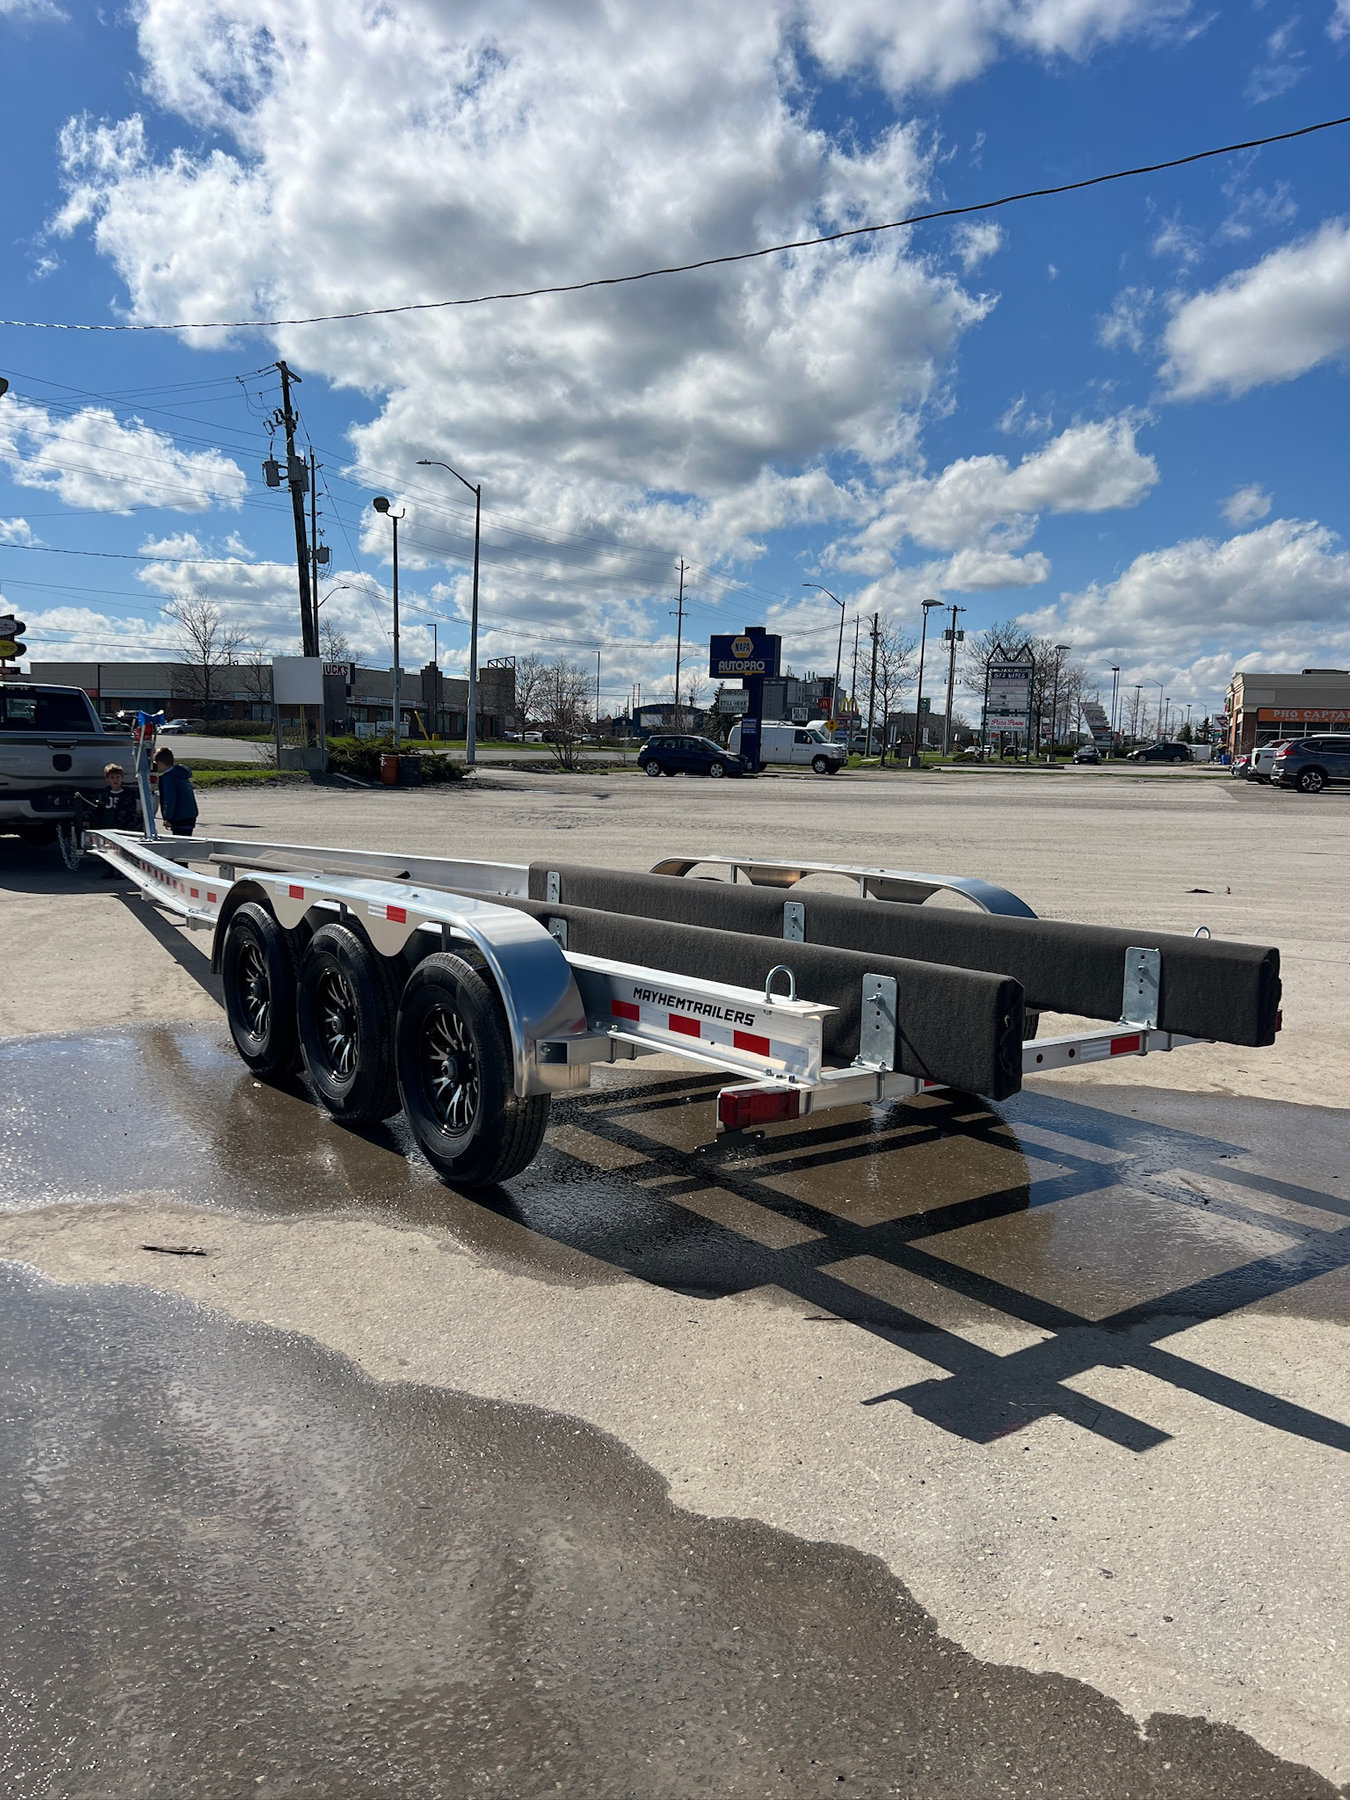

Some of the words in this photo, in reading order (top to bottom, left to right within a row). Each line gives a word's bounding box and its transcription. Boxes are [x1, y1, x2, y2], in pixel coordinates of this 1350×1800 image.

[735, 642, 750, 652] NAPA
[718, 660, 765, 671] AUTOPRO
[1273, 710, 1298, 718] PHO
[633, 987, 756, 1026] MAYHEMTRAILERS
